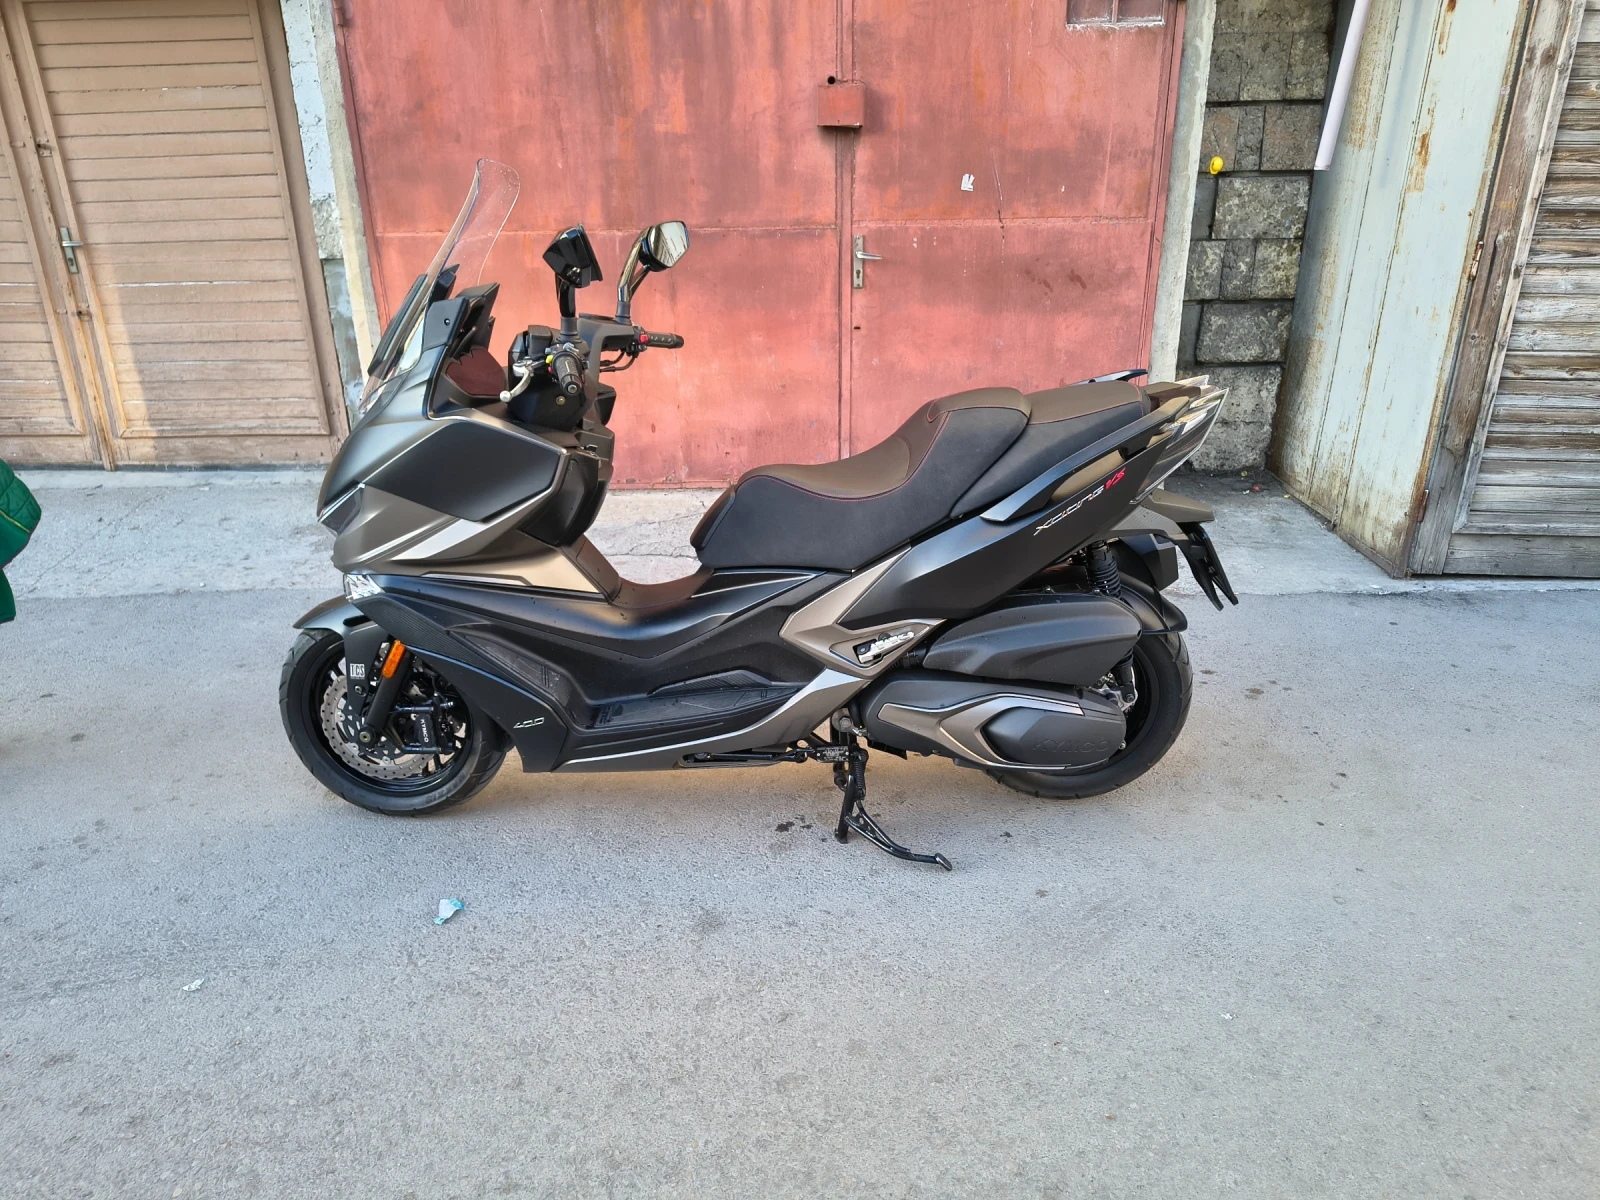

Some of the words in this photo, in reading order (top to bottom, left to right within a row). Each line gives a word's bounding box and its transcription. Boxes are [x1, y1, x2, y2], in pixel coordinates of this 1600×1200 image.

[350, 664, 365, 676] TCS
[513, 717, 545, 728] 400
[420, 718, 430, 743] KYMCO
[1032, 737, 1111, 753] KYMCO
